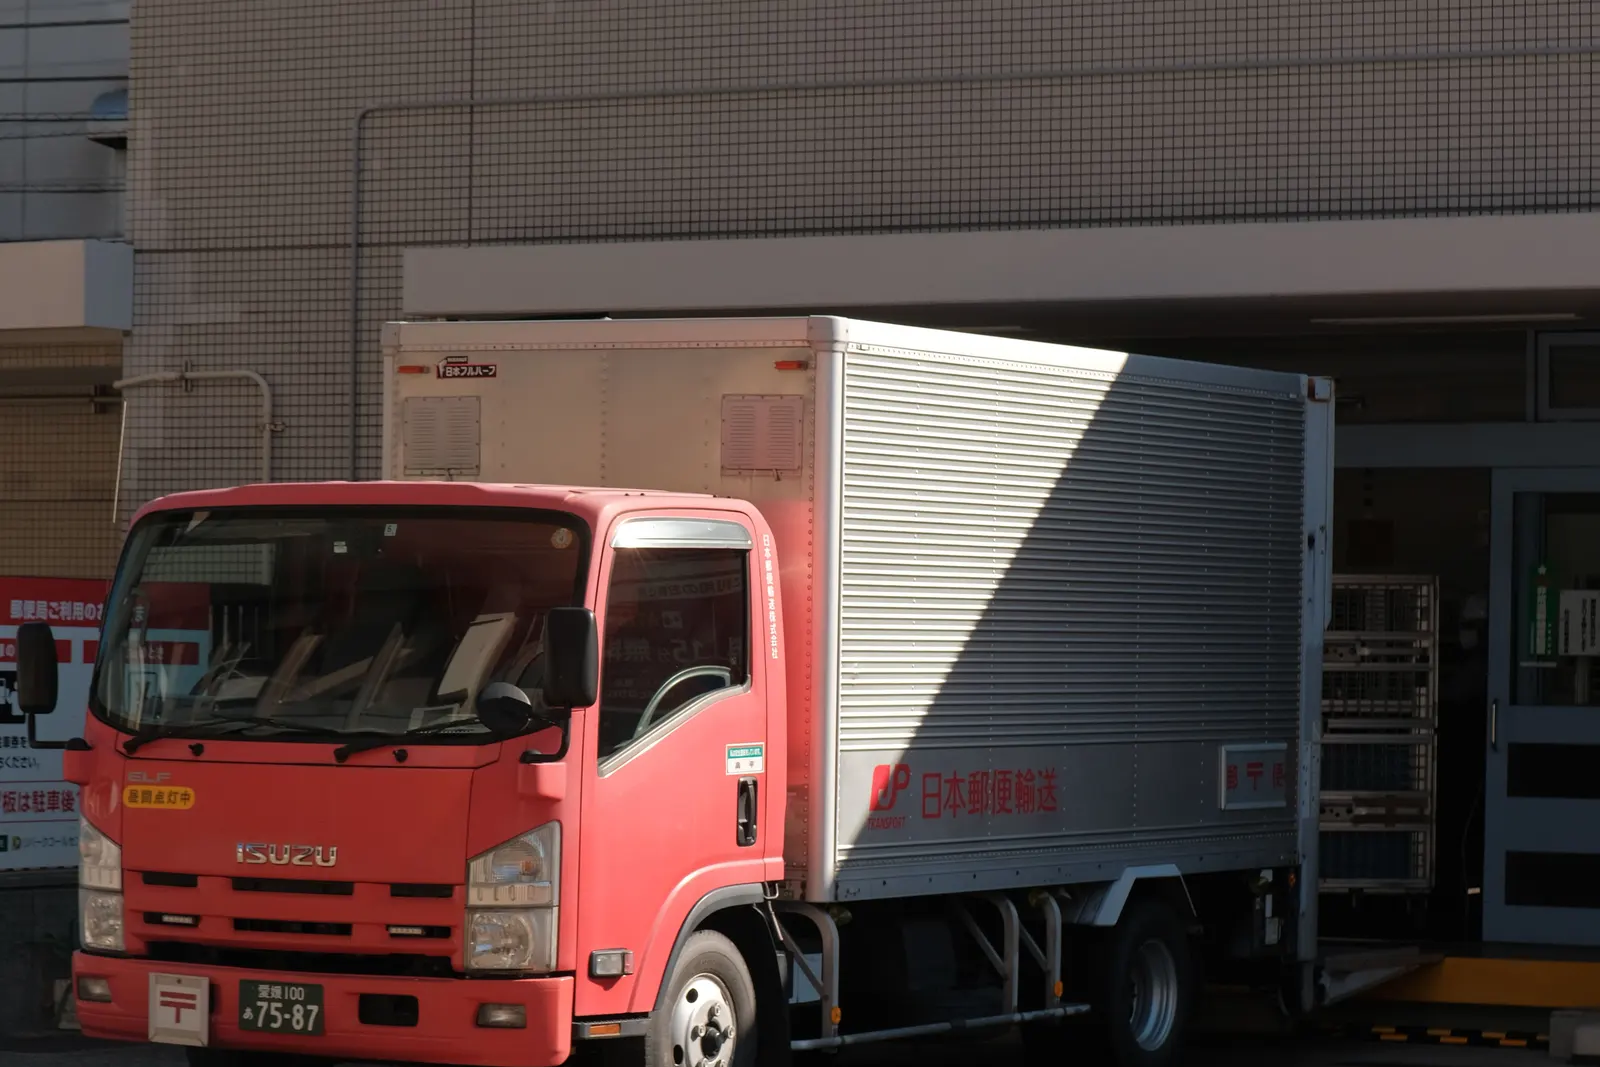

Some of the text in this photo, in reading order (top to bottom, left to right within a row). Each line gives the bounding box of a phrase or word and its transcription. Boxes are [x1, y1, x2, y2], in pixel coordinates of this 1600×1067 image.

[445, 366, 496, 377] 日本フルハーフ
[127, 771, 171, 783] ELF
[2, 790, 80, 814] 板は駐車後
[921, 767, 1060, 819] 日本郵便輸送
[236, 843, 338, 867] ISUZU
[256, 1001, 320, 1032] 75-87
